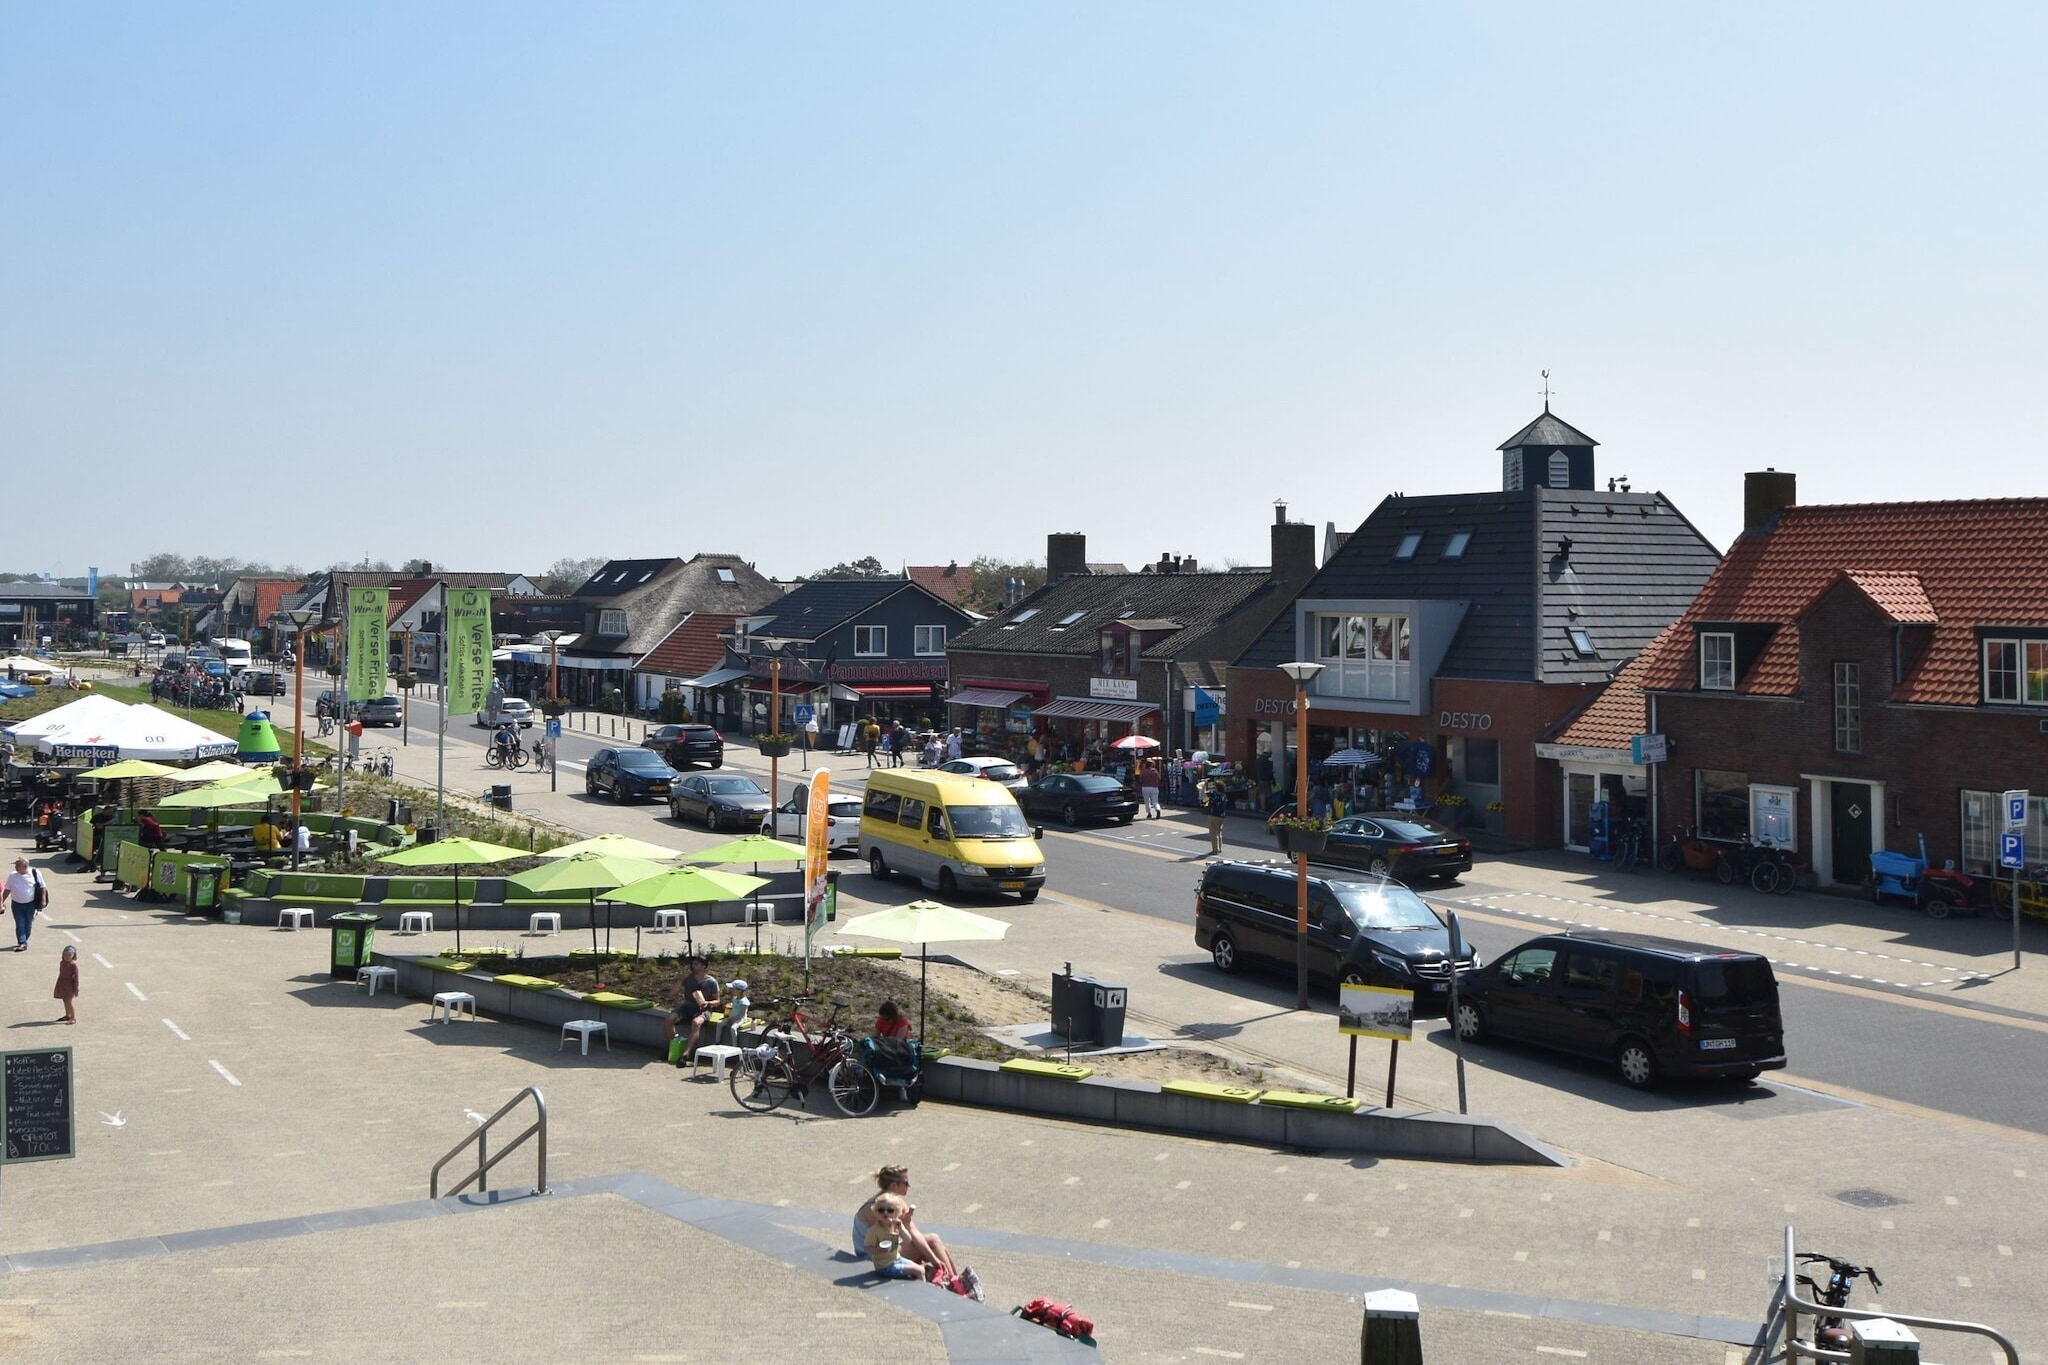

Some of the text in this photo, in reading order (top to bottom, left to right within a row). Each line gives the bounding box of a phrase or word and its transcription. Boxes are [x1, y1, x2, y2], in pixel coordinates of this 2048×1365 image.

[368, 620, 381, 695] Verse Frites
[472, 623, 485, 709] Verse Frites
[828, 662, 949, 680] Pannenkoeken
[1196, 702, 1219, 710] DESTO
[1255, 698, 1297, 715] DESTO
[551, 721, 559, 731] P
[1440, 711, 1493, 731] DESTO
[55, 744, 117, 759] Heineken
[199, 743, 237, 759] Heineken
[2013, 801, 2022, 818] P
[2005, 836, 2018, 853] P
